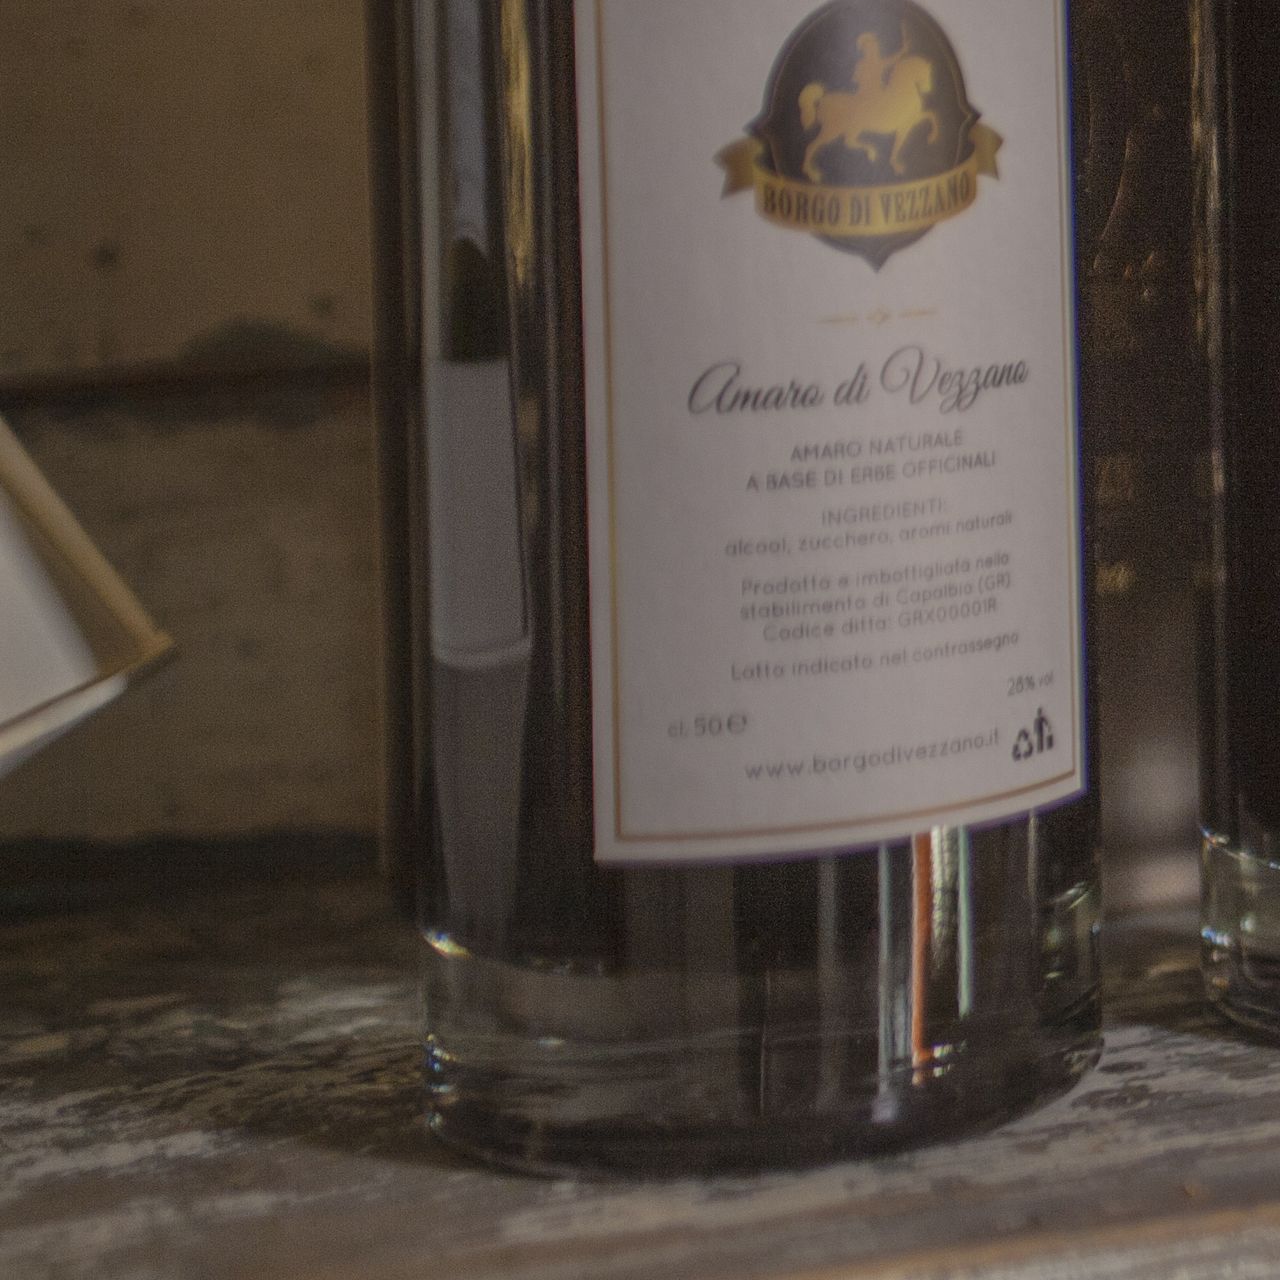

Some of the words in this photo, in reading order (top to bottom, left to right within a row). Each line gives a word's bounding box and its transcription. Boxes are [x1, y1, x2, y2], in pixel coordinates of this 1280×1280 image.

[763, 182, 841, 225] BORGO
[848, 193, 872, 227] DI
[880, 173, 972, 221] VEZZANO
[687, 359, 825, 415] Amaro
[833, 361, 872, 406] di
[879, 344, 1030, 414] Vezzano
[790, 439, 862, 462] AMARO
[868, 429, 964, 456] NATURALE
[746, 474, 759, 491] A
[765, 468, 817, 490] BASE
[823, 470, 844, 487] DI
[850, 464, 896, 484] ERBE
[902, 451, 997, 478] OFFICINALI
[898, 518, 952, 541] aromi
[955, 510, 1013, 536] naturali
[740, 597, 867, 621] stabilimento
[872, 590, 891, 608] di
[895, 580, 974, 608] Capalbio
[741, 575, 833, 597] Prodotto
[838, 575, 850, 588] e
[762, 620, 835, 643] Codice
[731, 661, 785, 681] Lotto
[791, 654, 874, 677] indicato
[879, 648, 908, 667] nel
[911, 631, 1020, 662] contrassegno
[744, 725, 1001, 780] www.borgodivezzano.it
